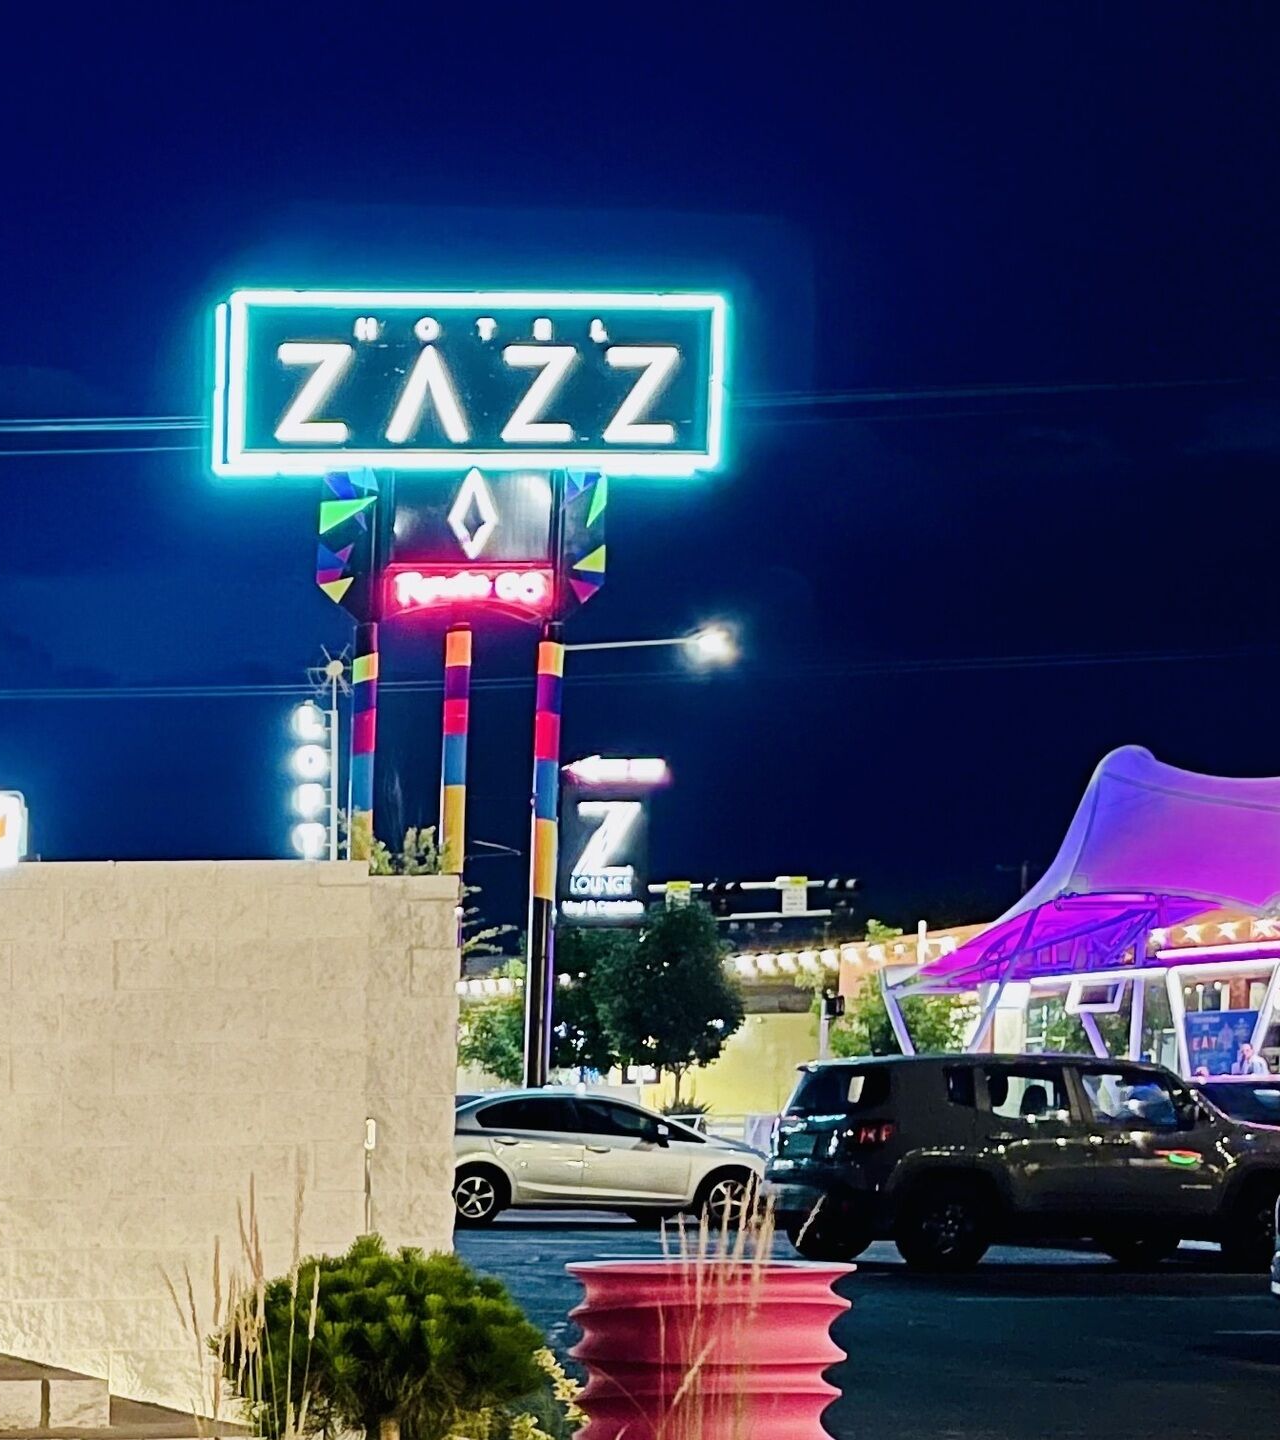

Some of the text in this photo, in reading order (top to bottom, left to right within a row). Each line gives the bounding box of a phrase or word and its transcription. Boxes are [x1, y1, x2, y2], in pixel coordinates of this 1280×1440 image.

[354, 317, 608, 342] HOTEL
[274, 342, 680, 444] ZAZZ
[571, 801, 642, 876] Z
[569, 875, 633, 896] LOUNGE
[1192, 1035, 1217, 1051] EAT
